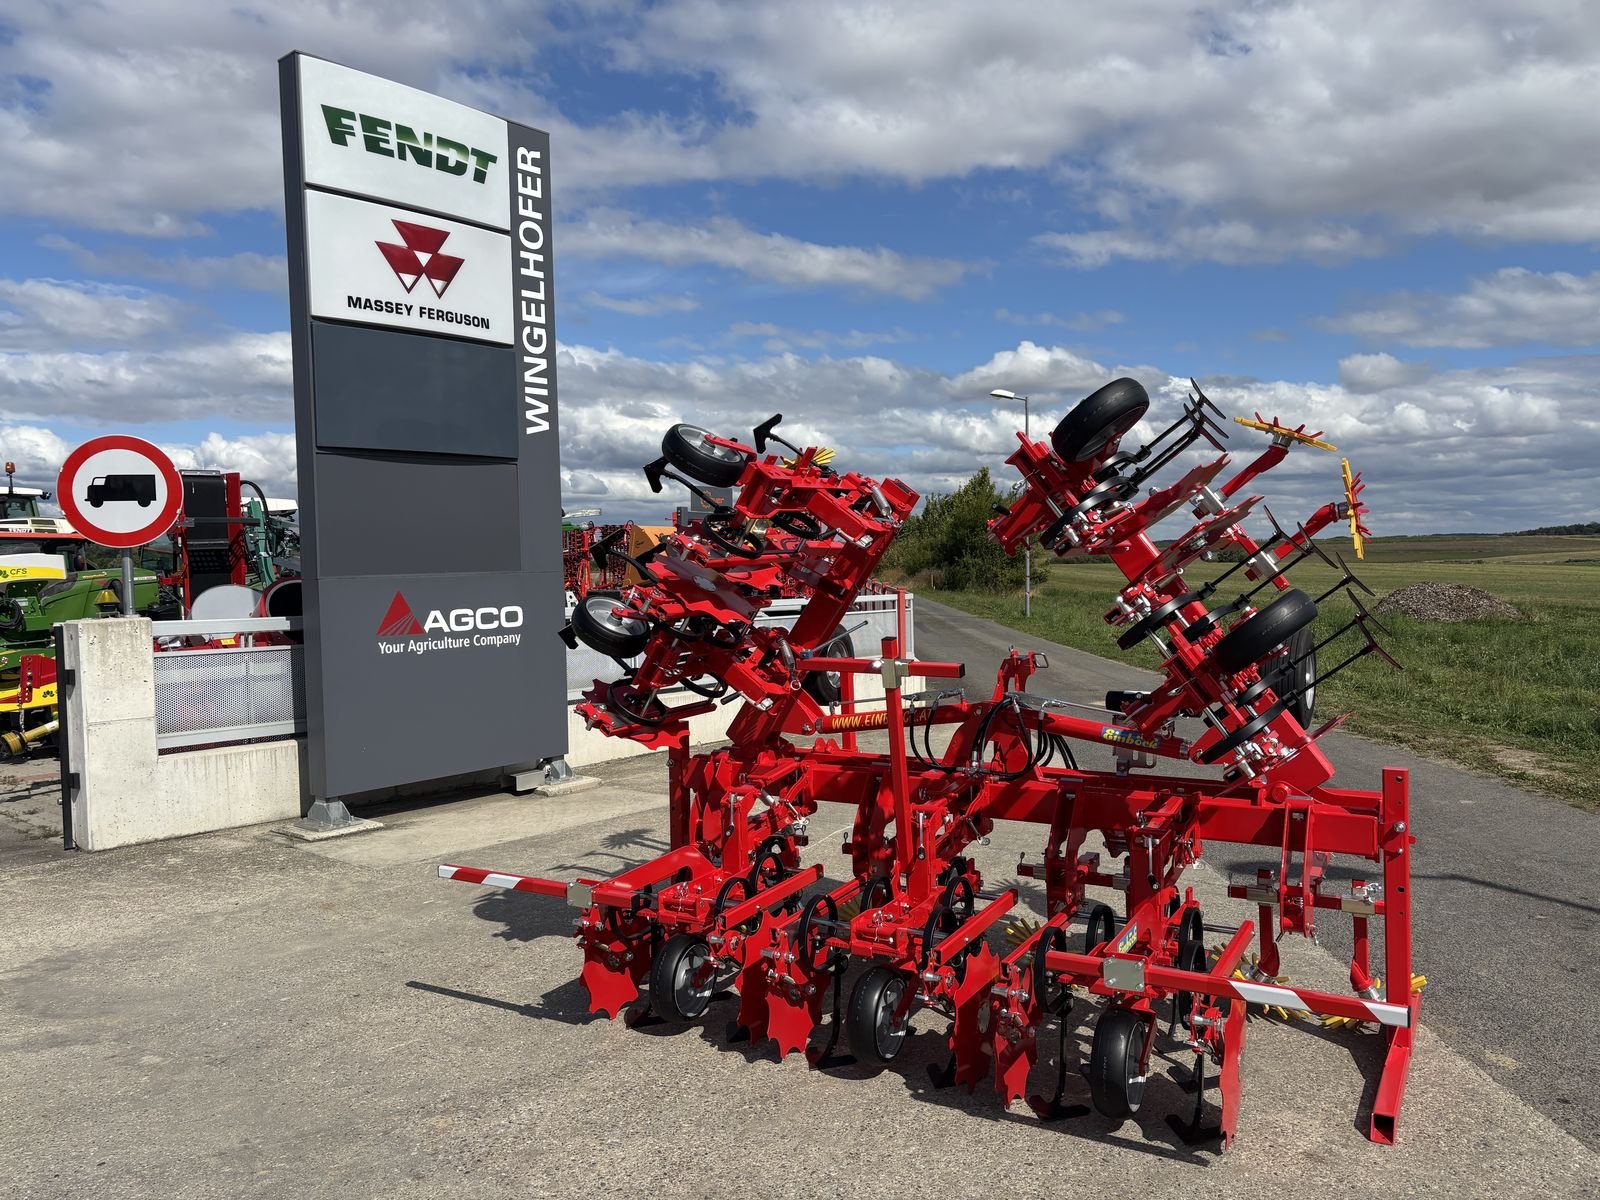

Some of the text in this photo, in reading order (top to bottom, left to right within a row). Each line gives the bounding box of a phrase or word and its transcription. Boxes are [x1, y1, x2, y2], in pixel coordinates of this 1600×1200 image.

[321, 104, 497, 184] FENDT
[517, 145, 550, 435] WINGELHOFER
[347, 295, 490, 330] MASSEY FERGUSON
[10, 568, 28, 576] CFS
[424, 605, 524, 633] AGCO
[378, 633, 521, 655] Your Agriculture Company
